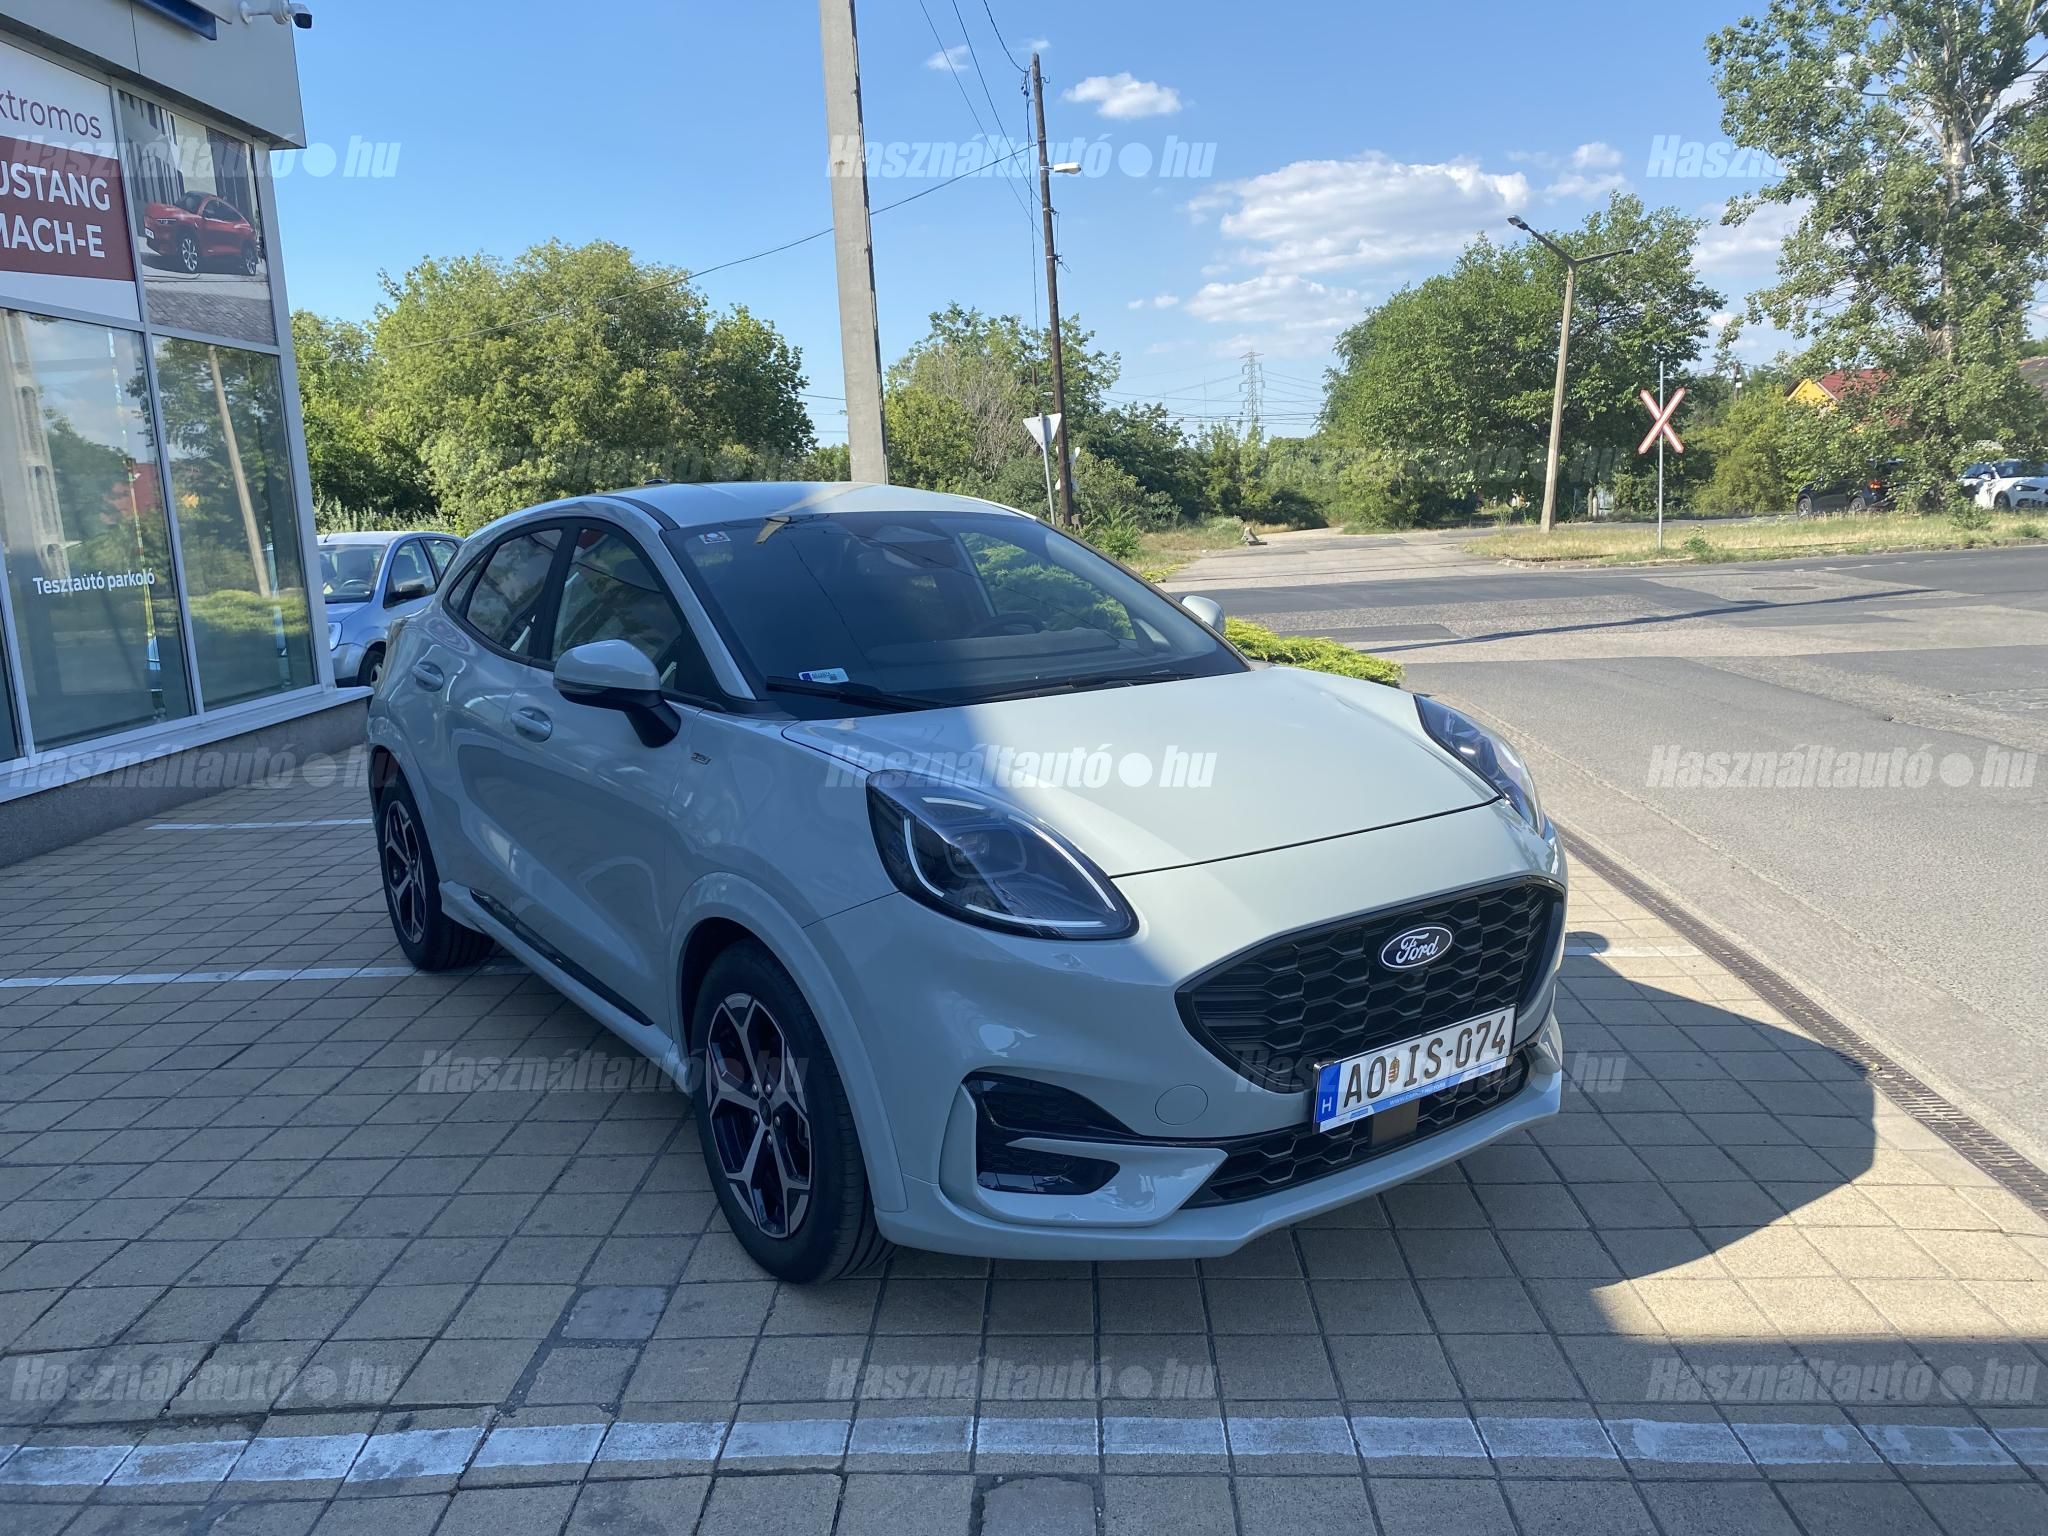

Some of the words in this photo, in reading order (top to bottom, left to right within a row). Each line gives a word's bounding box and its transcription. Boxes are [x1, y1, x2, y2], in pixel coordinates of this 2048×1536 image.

[107, 568, 155, 591] parkoló
[1396, 932, 1440, 964] Ford
[1321, 1096, 1333, 1114] H
